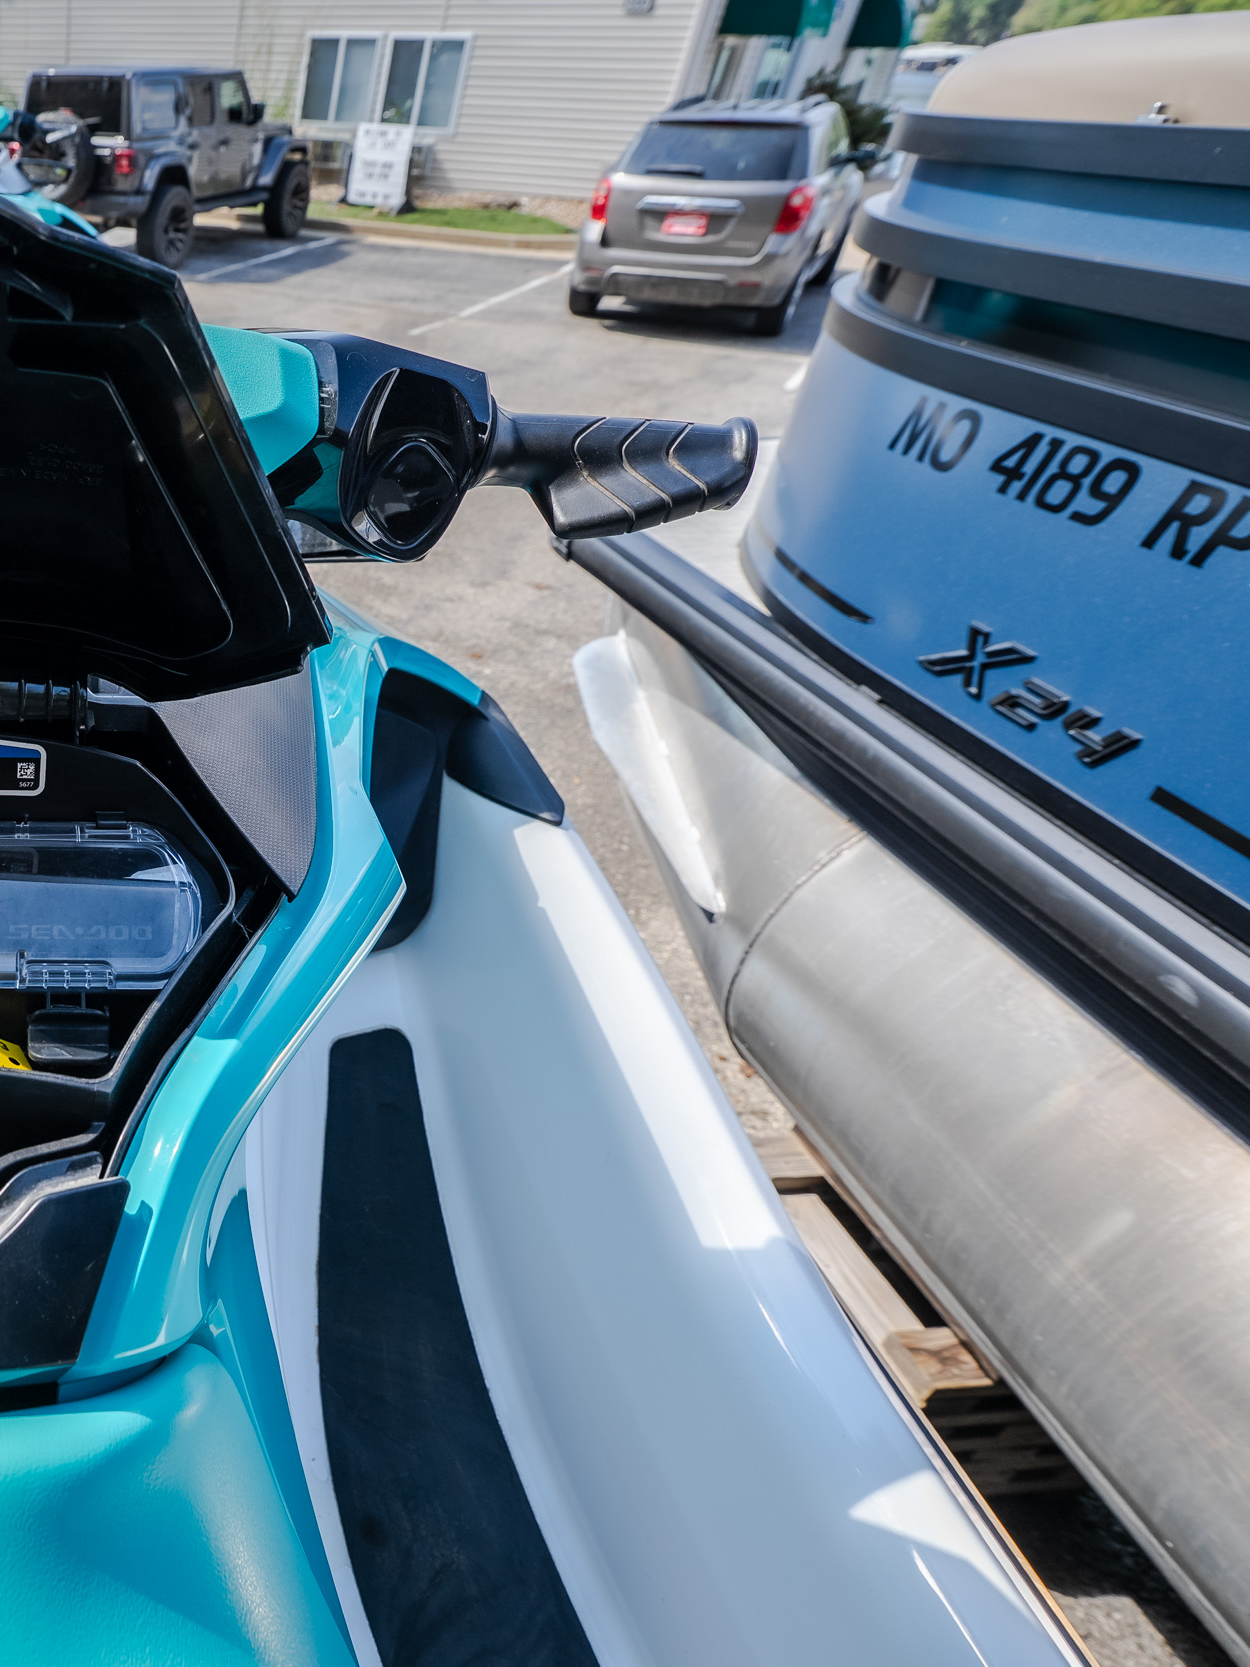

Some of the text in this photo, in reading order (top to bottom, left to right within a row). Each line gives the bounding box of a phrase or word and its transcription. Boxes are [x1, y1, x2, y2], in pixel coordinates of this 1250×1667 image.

[887, 394, 1250, 569] MO 4189 RP
